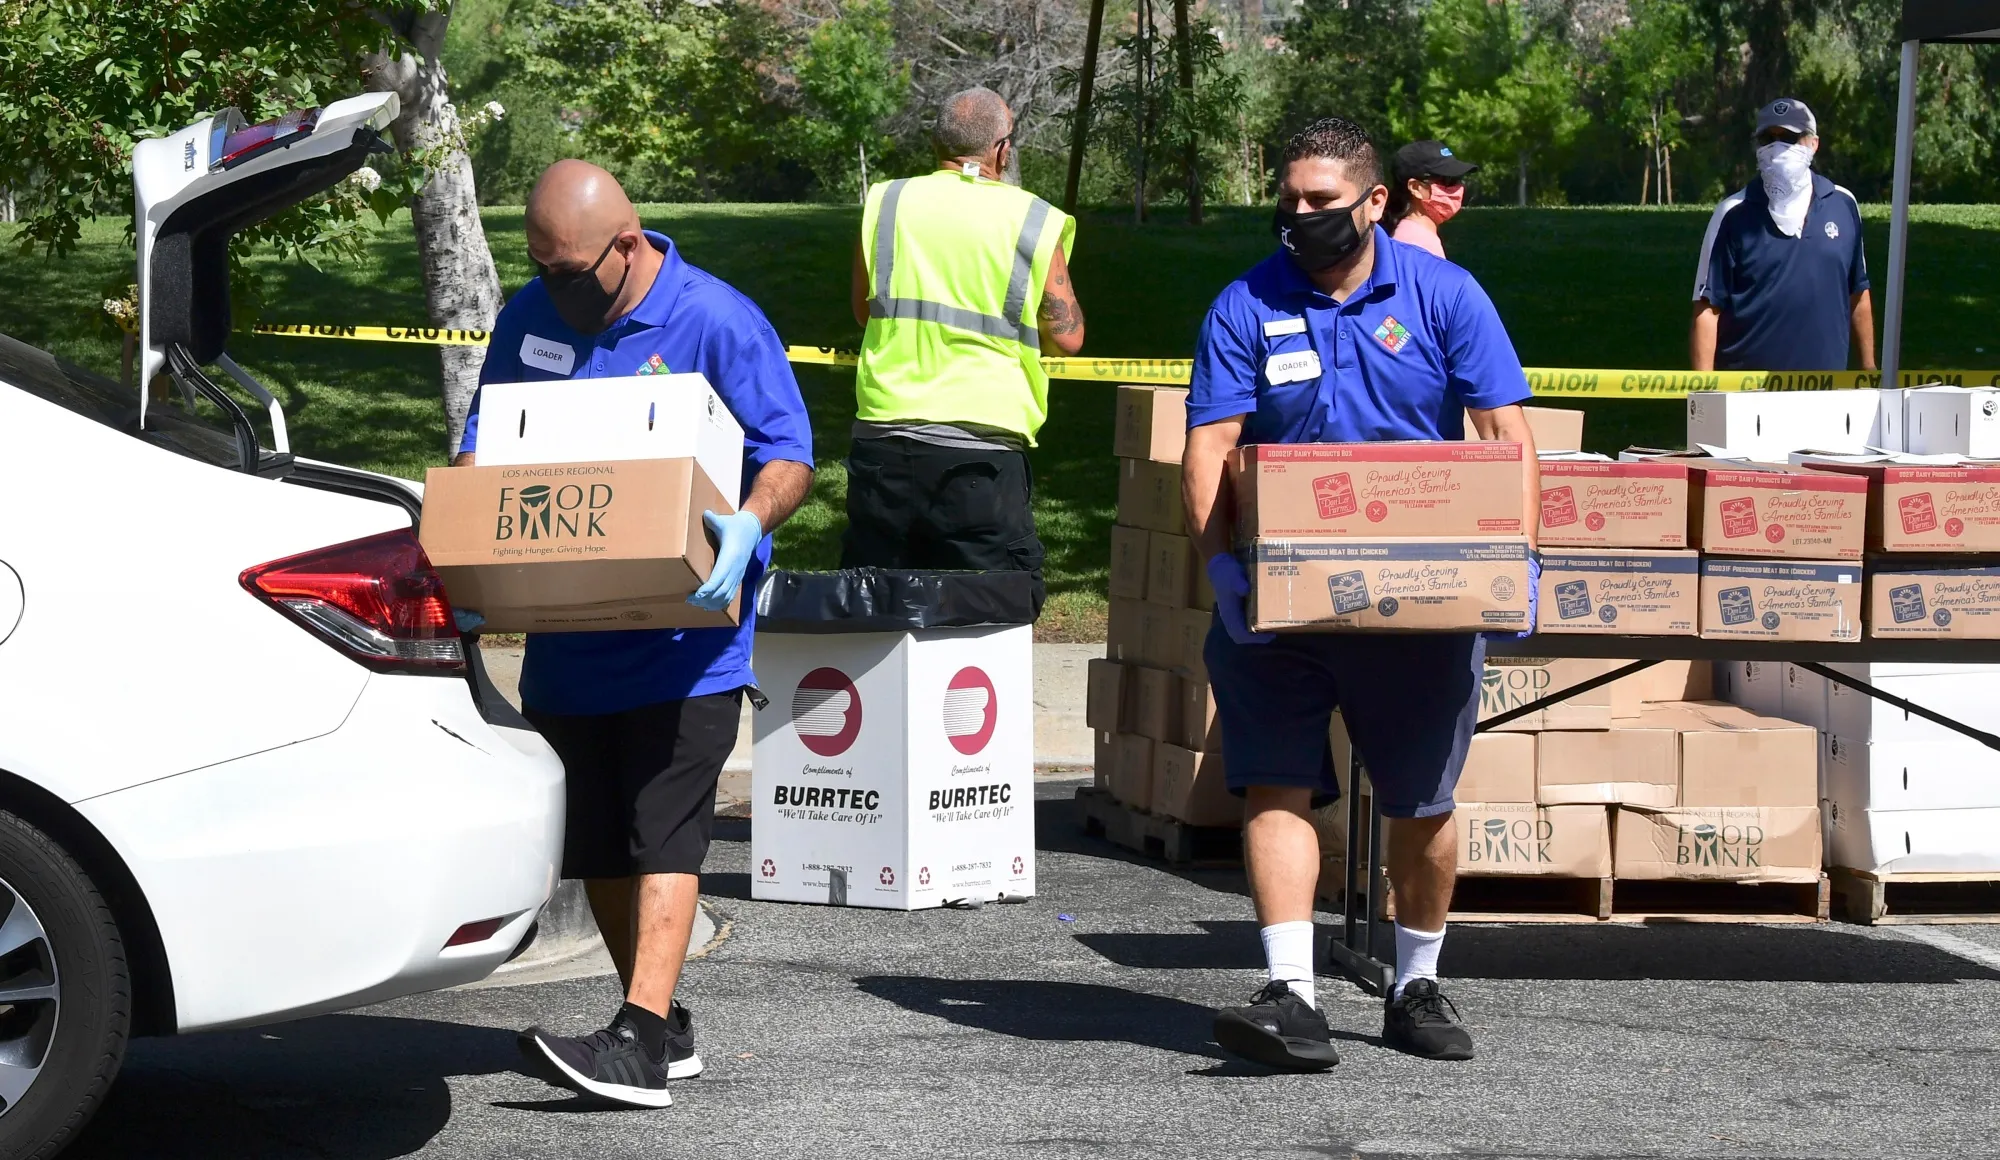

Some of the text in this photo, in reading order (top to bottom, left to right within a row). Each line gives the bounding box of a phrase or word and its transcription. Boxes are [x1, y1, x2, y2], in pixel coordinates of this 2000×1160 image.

[386, 327, 486, 341] CAUTIO
[1393, 330, 1412, 352] DUARTE
[532, 347, 563, 362] LOADER
[1278, 361, 1308, 371] LOADER
[502, 466, 615, 478] LOS ANGELES REGIONAL
[1367, 466, 1452, 485] Proudly Serving
[1361, 480, 1461, 499] America's Families
[1587, 482, 1664, 497] Proudly Serving
[1945, 490, 1984, 504] Proudly
[1581, 495, 1673, 510] America's Families
[1768, 495, 1844, 510] Proudly Serving
[1941, 503, 1989, 516] America's
[1762, 507, 1852, 522] America's Families
[493, 545, 608, 557] Fighting Hunger. Giving Hope.
[1360, 548, 1389, 556] (CHICKEN)
[1378, 565, 1459, 581] Proudly Serving
[1791, 568, 1816, 576] (CHICKEN)
[1373, 578, 1468, 595] America's Families
[1600, 576, 1672, 591] Proudly Serving
[1935, 579, 2000, 595] Proudly Servin
[1595, 588, 1680, 604] America's Families
[1764, 584, 1836, 599] Proudly Serving
[1758, 596, 1842, 610] America's Families
[1929, 594, 1976, 607] America's
[802, 764, 853, 778] Compliments of
[951, 765, 983, 776] Compliments
[774, 786, 879, 810] BURRTEC
[929, 783, 1011, 810] BURRTEC
[808, 810, 828, 821] Take
[831, 812, 852, 822] Care
[855, 813, 868, 825] Of
[956, 811, 972, 821] Take
[974, 809, 991, 819] Care
[993, 807, 1003, 819] Of
[952, 861, 992, 872] 1-888-287-7832
